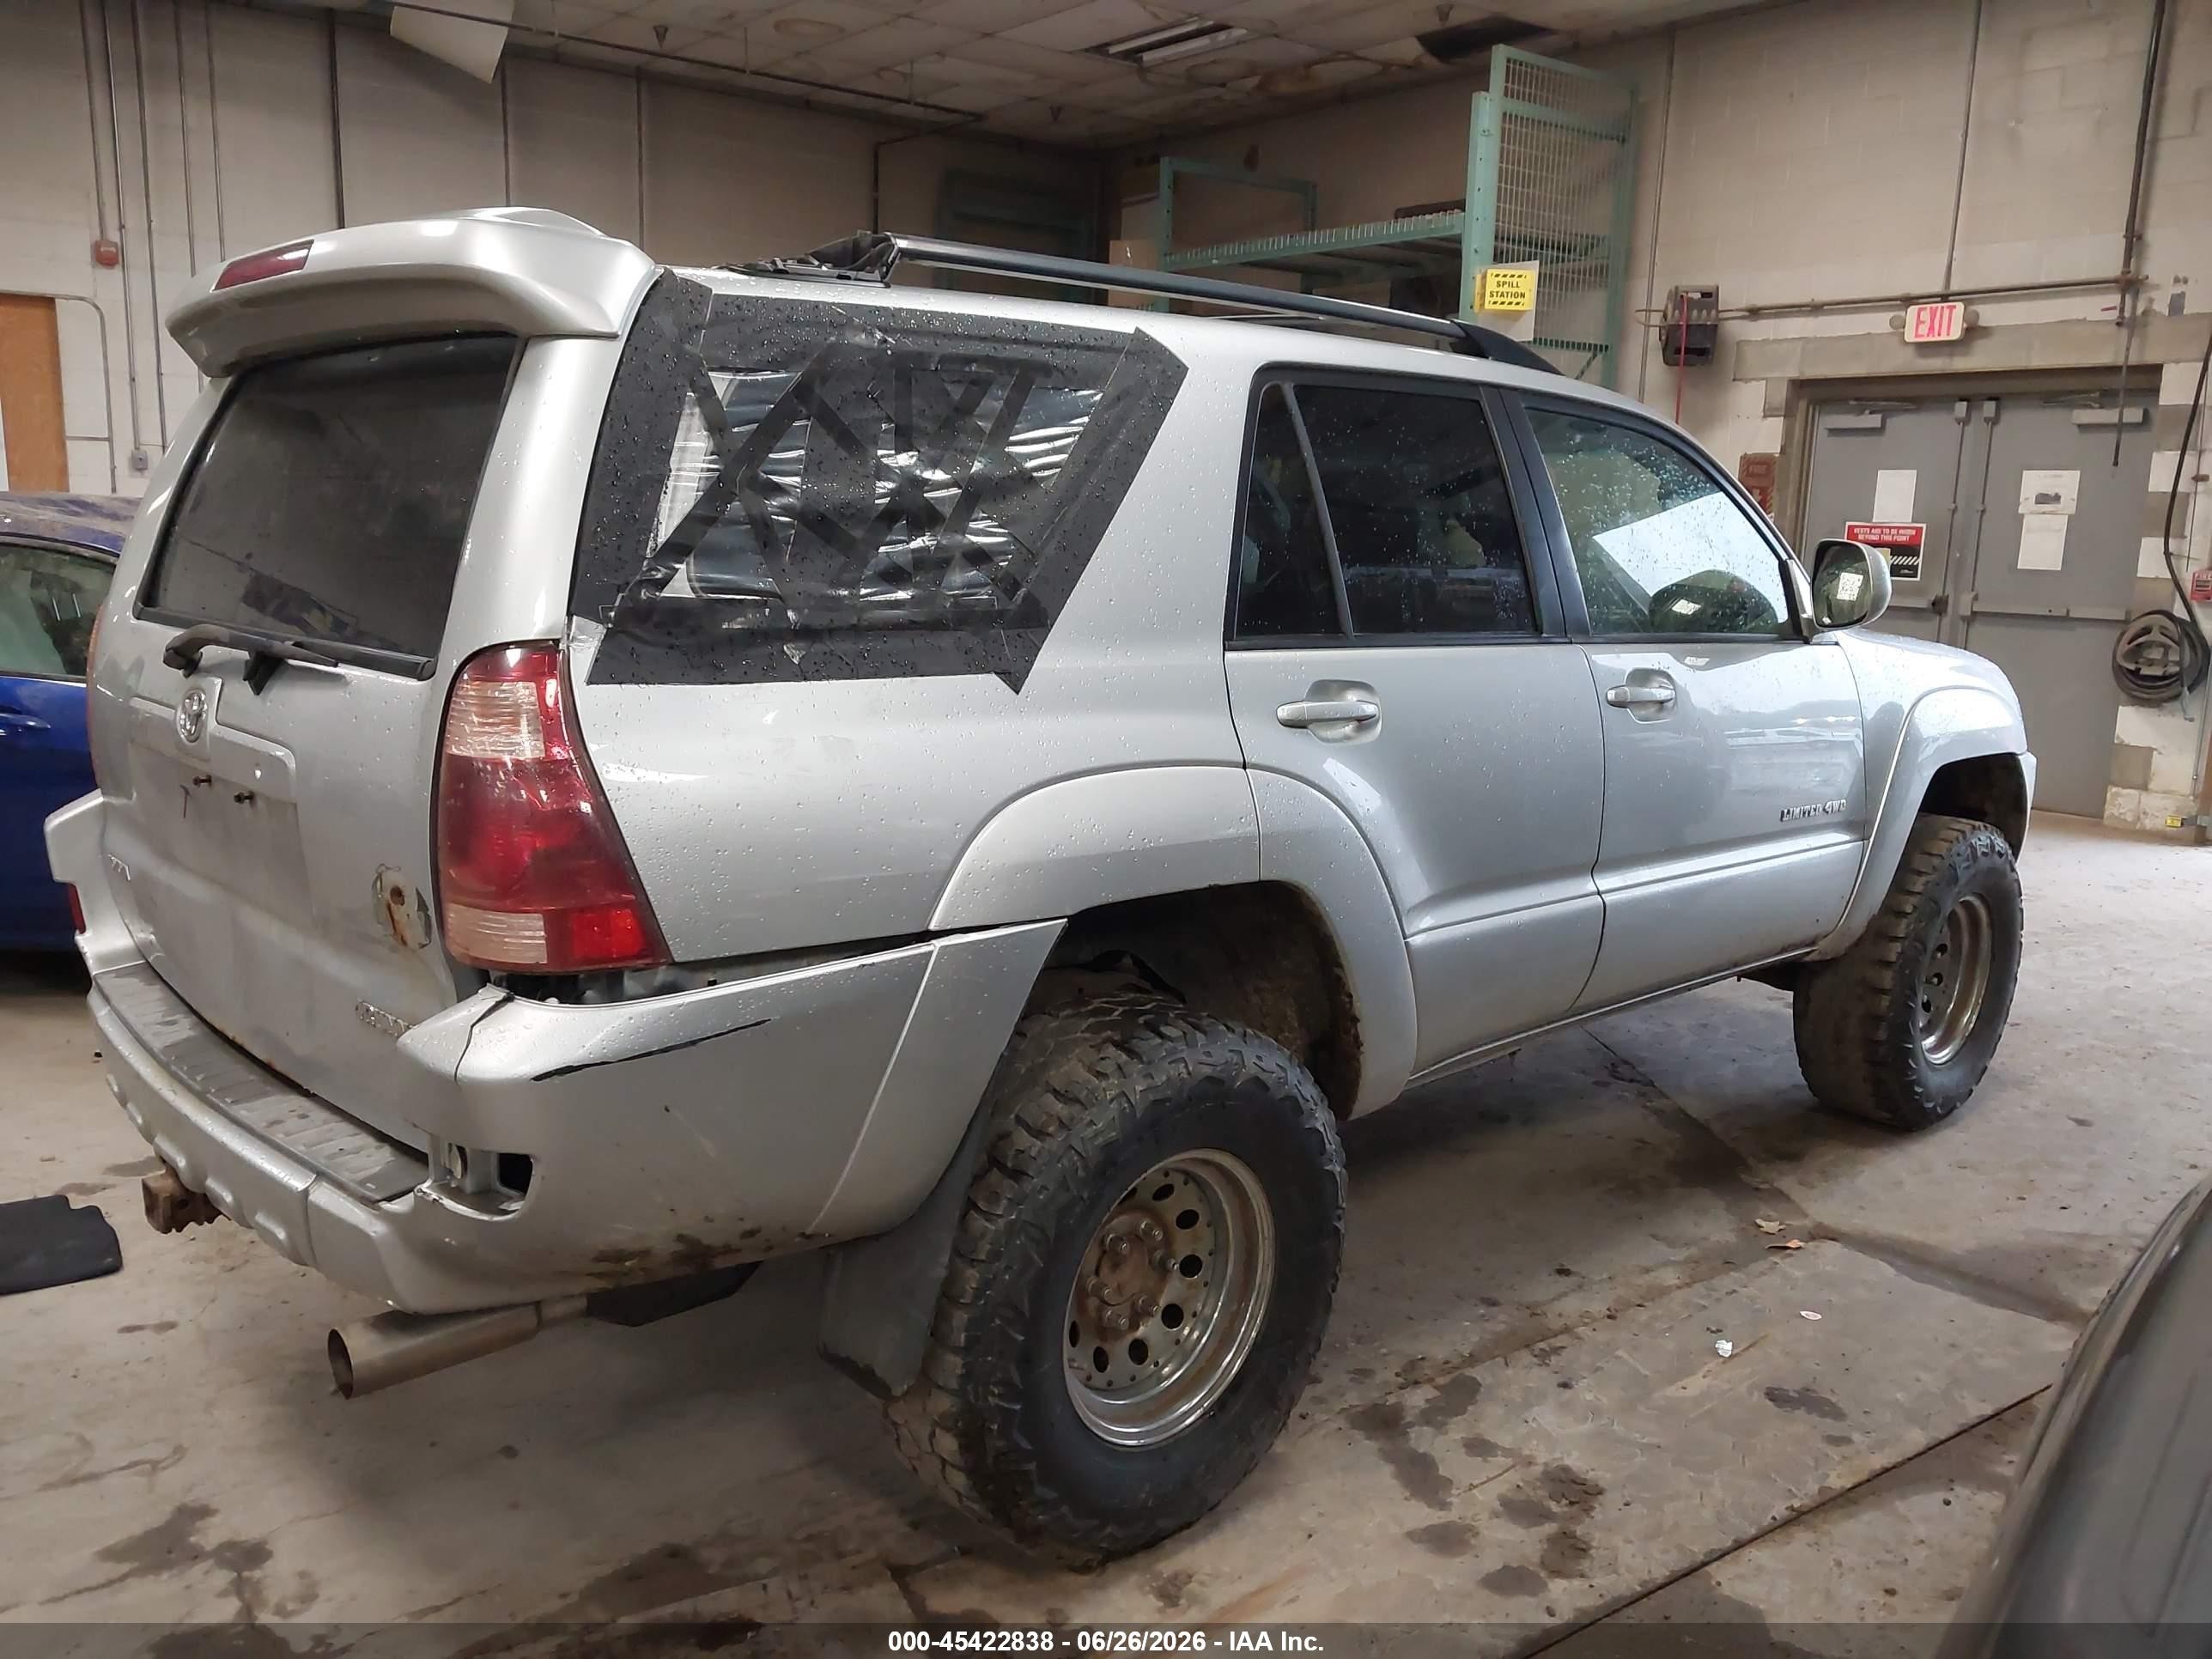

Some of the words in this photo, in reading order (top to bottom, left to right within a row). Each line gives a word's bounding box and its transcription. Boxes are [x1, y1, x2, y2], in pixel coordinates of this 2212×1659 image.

[1914, 305, 1957, 338] EXIT
[1780, 804, 1821, 822] LIMITED
[1823, 799, 1847, 814] 4WD
